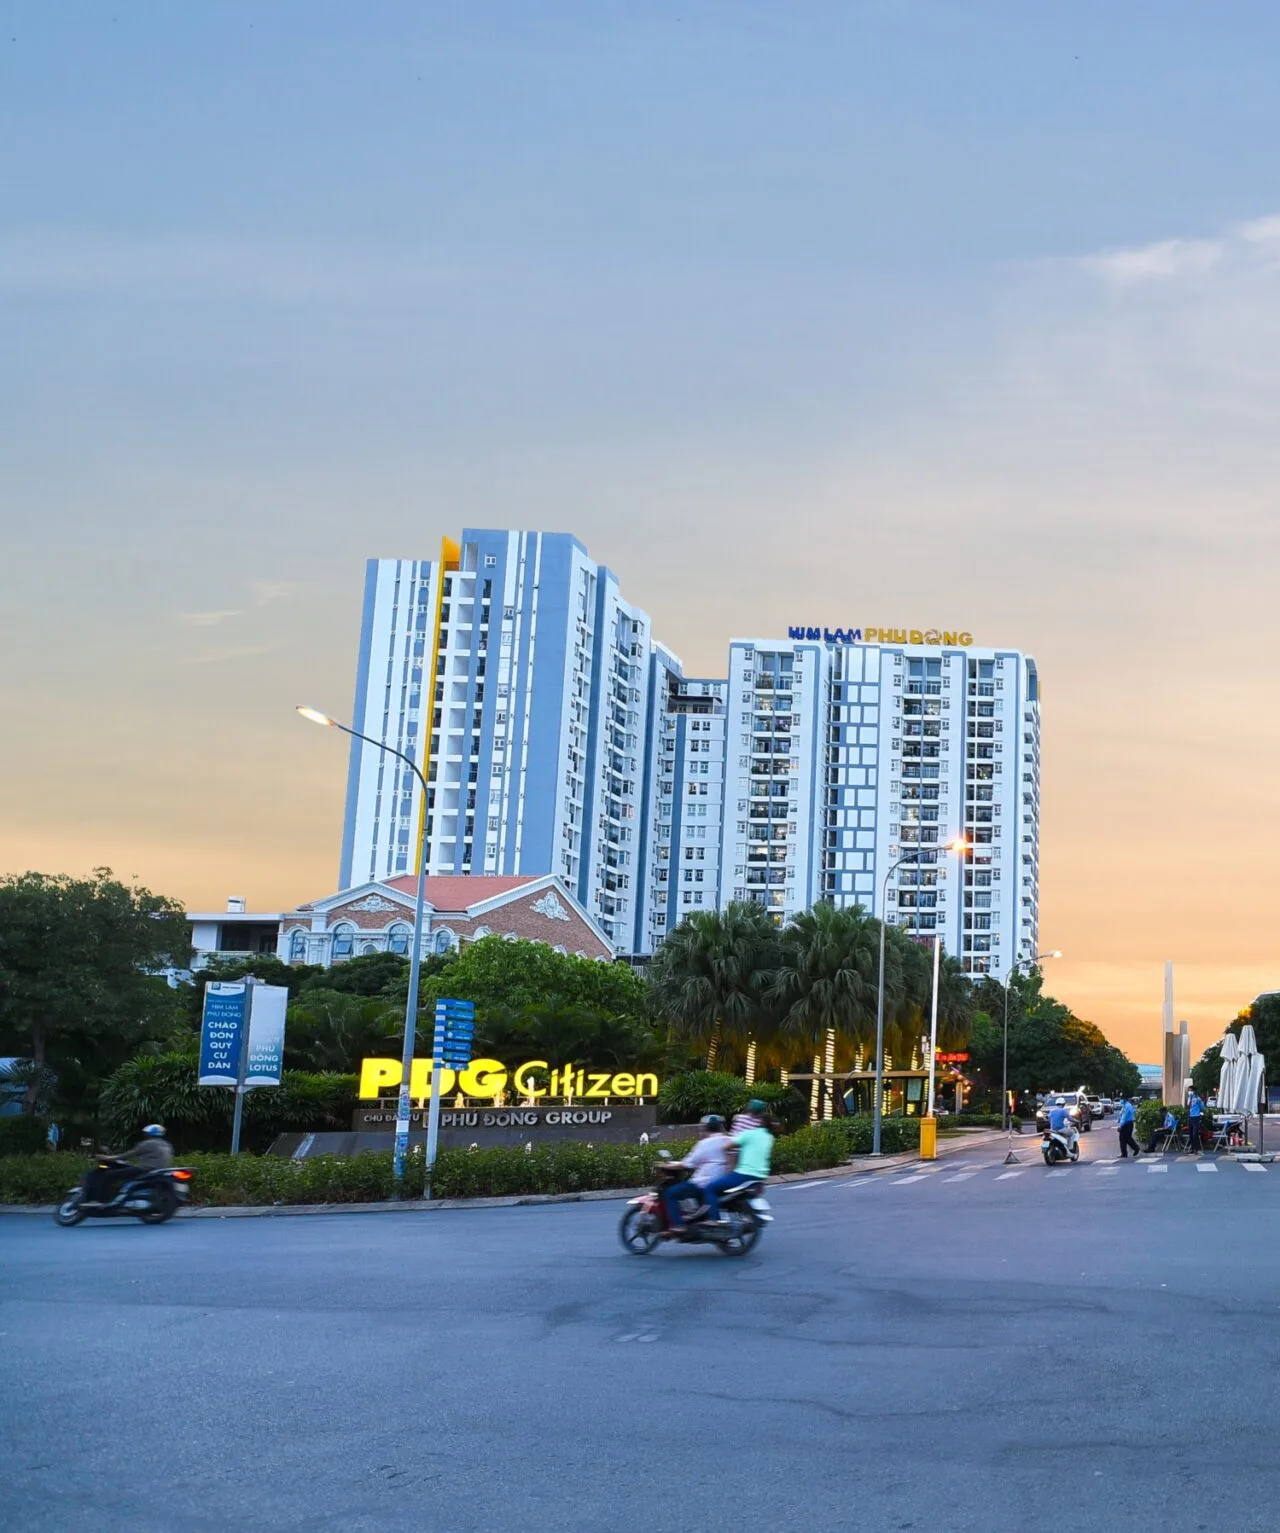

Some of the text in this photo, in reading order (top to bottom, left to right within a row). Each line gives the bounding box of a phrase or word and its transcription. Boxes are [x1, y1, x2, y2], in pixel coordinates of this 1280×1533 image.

[824, 627, 862, 643] LAM
[249, 1064, 278, 1072] LOTUS
[359, 1058, 659, 1098] PDG Citizen
[441, 1110, 478, 1127] PHÚ
[546, 1111, 612, 1124] GROUP
